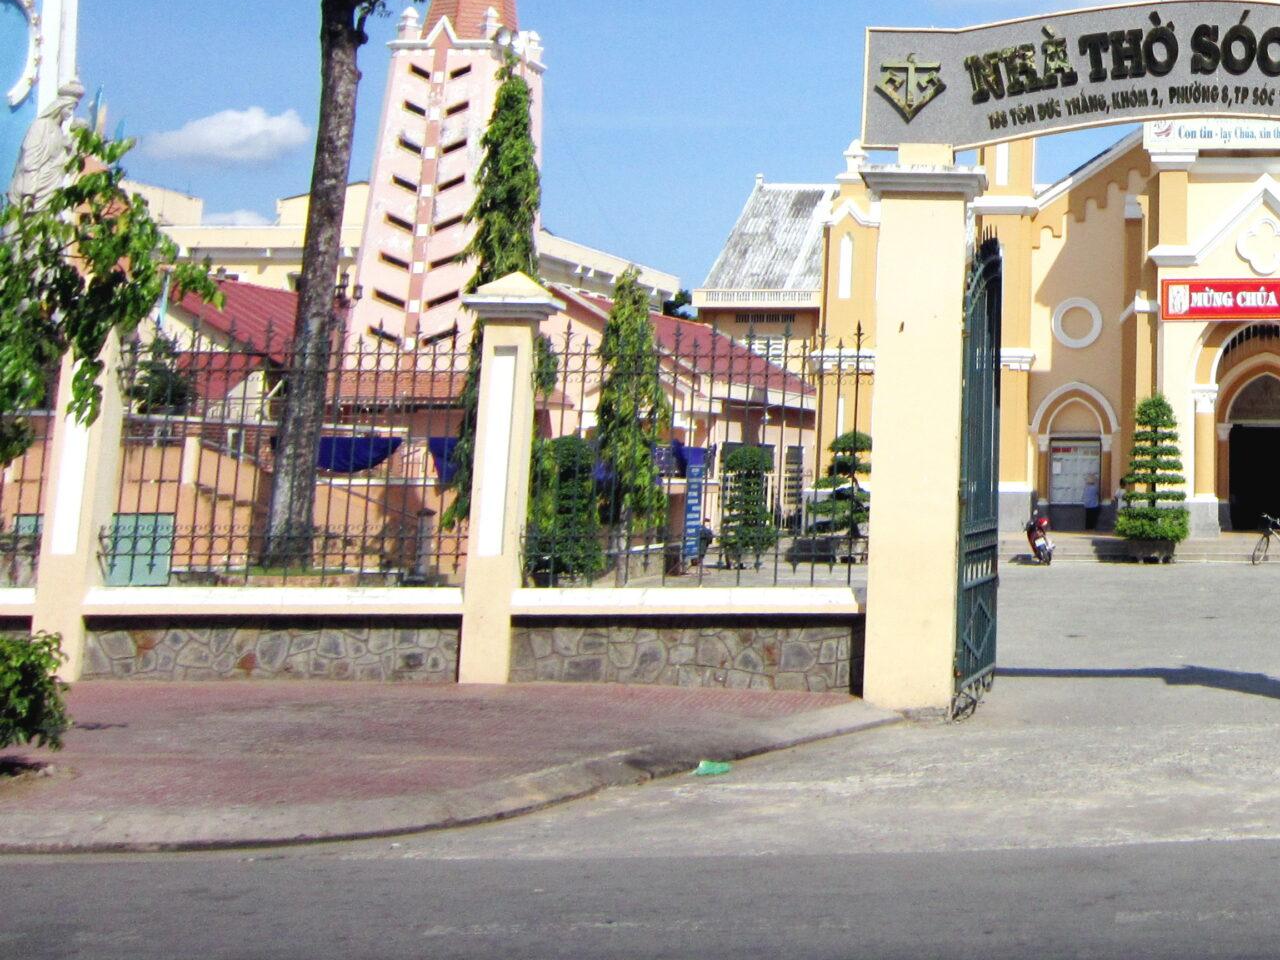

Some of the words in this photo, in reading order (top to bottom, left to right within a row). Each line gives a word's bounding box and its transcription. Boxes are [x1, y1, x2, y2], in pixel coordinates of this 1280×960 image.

[963, 24, 1078, 105] NHÀ
[1078, 10, 1179, 83] THỜ
[1009, 103, 1036, 126] TÔN
[1111, 84, 1149, 110] KHÓM
[1168, 81, 1219, 104] PHƯỜNG
[1252, 82, 1276, 107] SÓC
[1190, 286, 1234, 307] MỪNG
[1236, 285, 1279, 307] CHÚA
